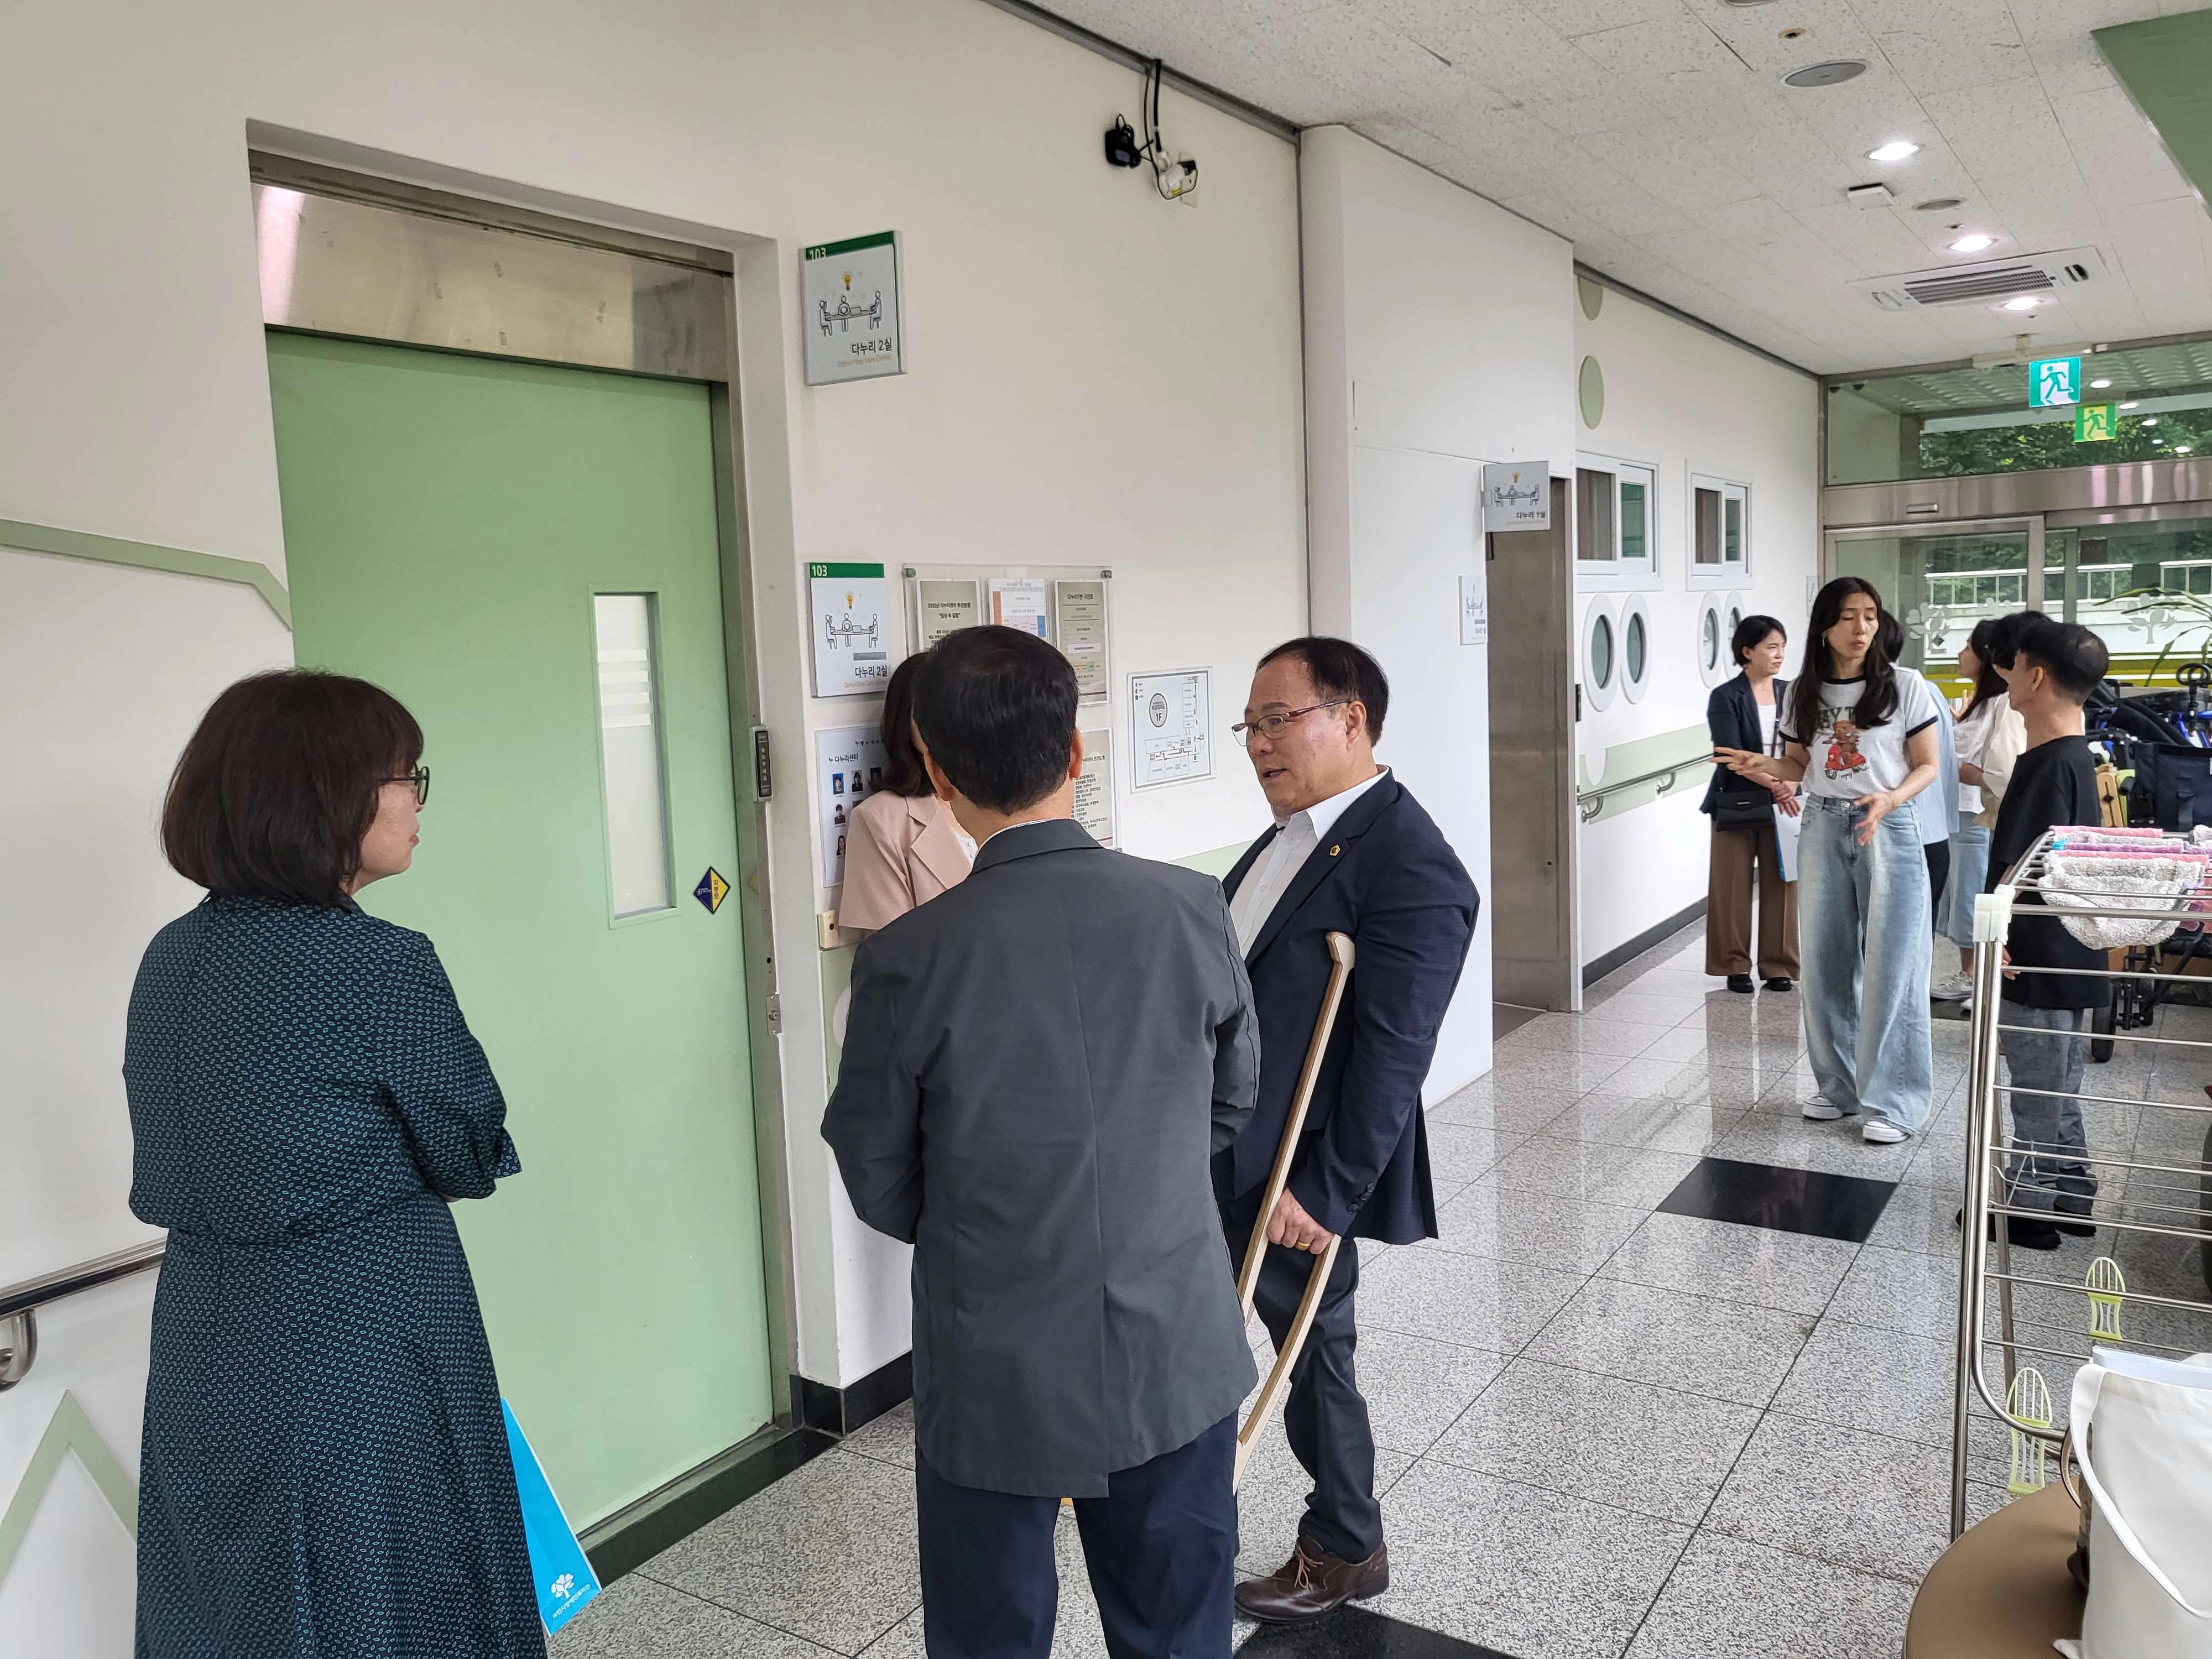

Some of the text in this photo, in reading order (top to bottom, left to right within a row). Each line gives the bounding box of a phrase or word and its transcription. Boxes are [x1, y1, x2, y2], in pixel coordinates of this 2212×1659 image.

[809, 247, 827, 262] 103
[852, 337, 892, 356] 다누리 2실
[1516, 510, 1546, 520] 다누리 1실
[812, 565, 827, 577] 103
[855, 664, 888, 679] 다누리 2실
[1156, 712, 1162, 722] 1F
[834, 753, 859, 763] 다누리센터
